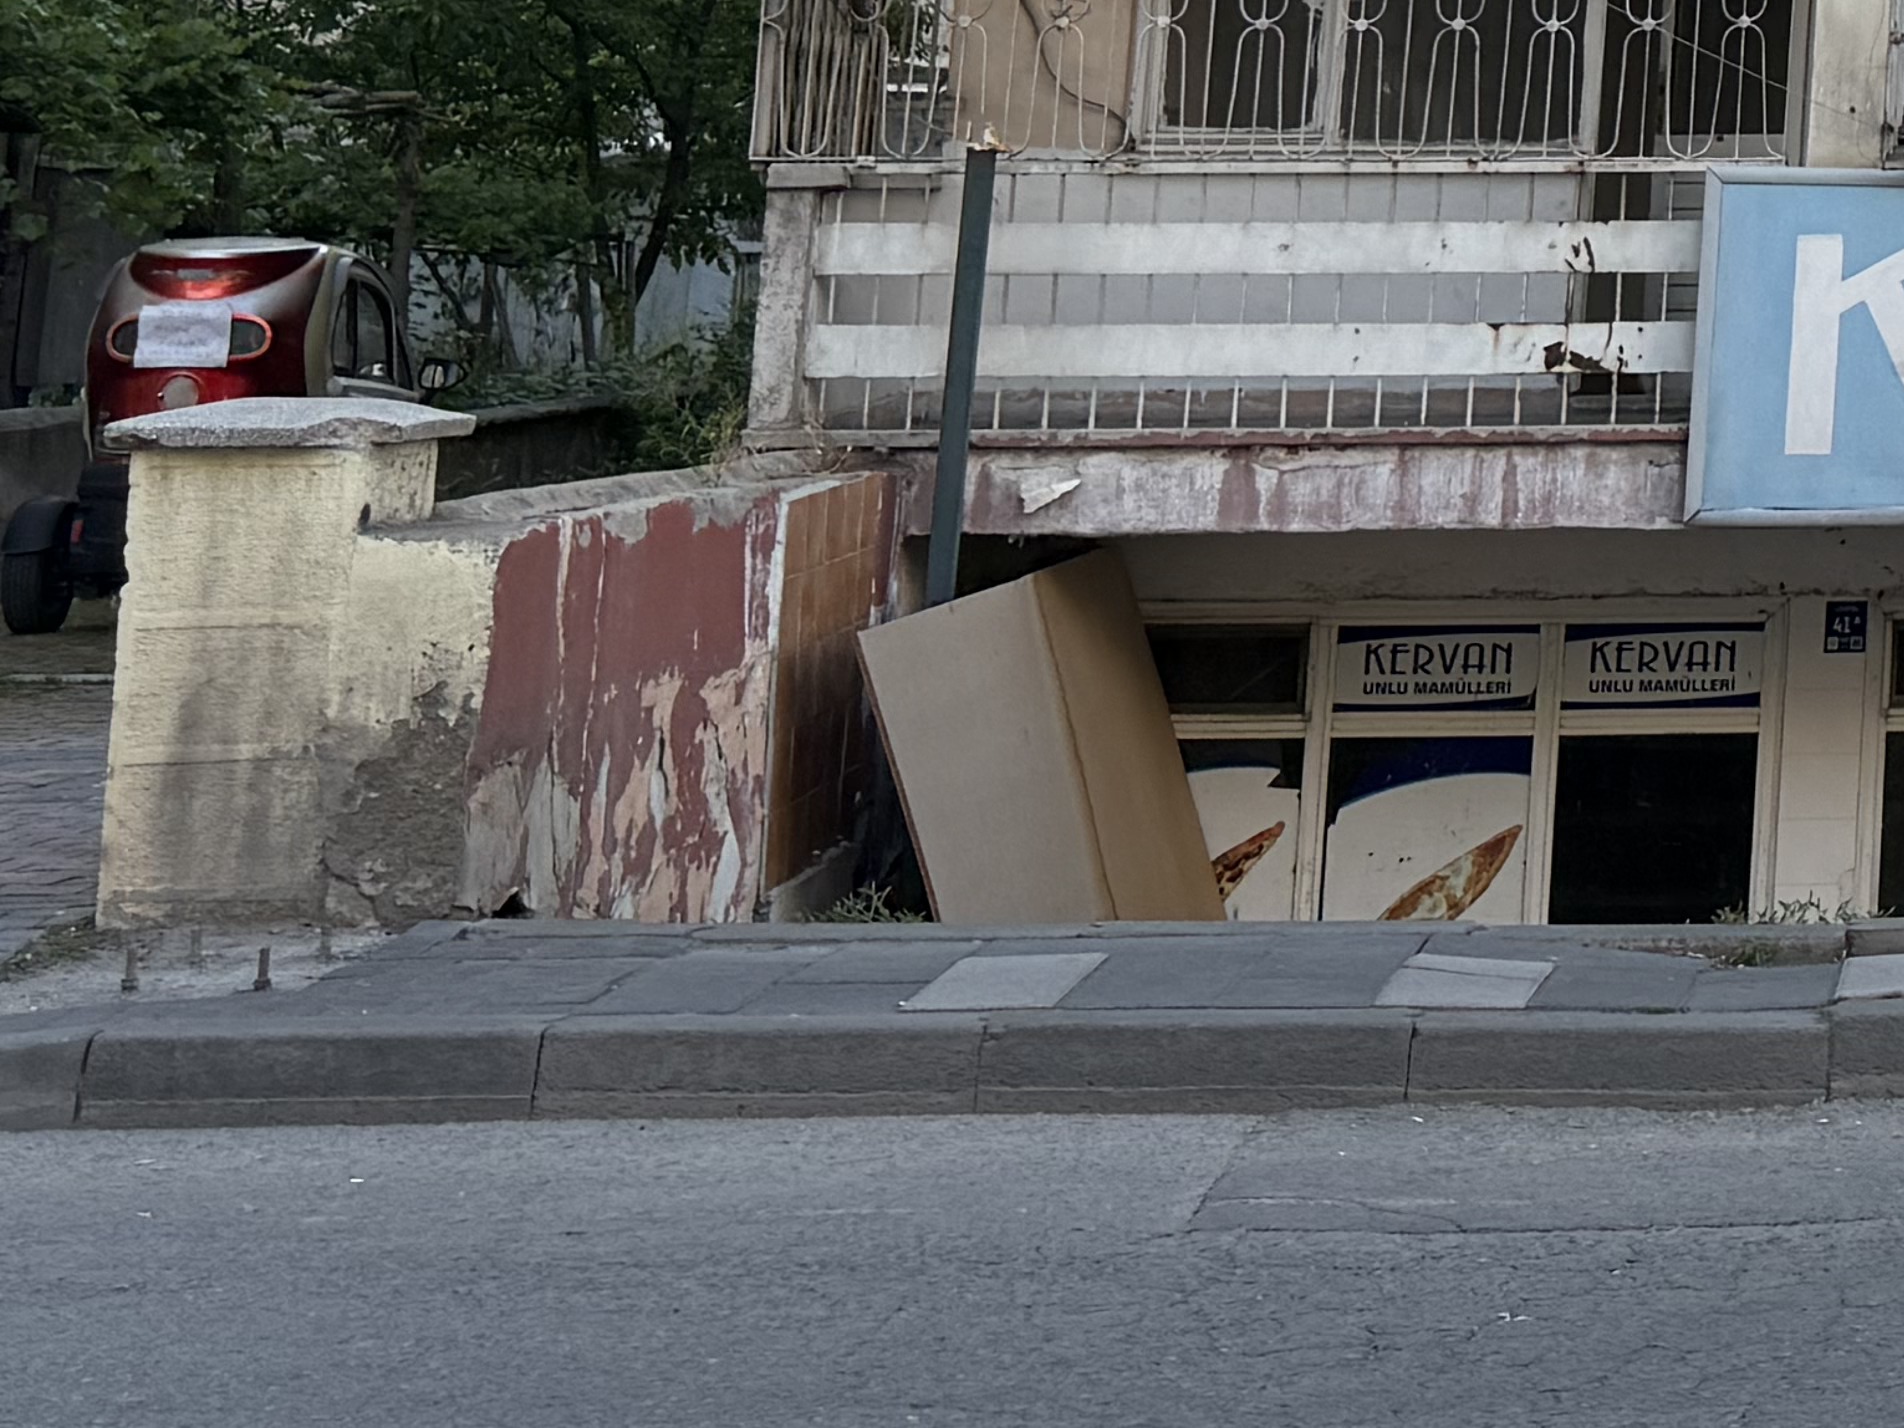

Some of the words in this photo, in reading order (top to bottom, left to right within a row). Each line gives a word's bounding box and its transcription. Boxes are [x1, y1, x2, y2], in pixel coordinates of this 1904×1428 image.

[1364, 642, 1513, 676] KERVAN
[1590, 639, 1737, 674] KERVAN
[1363, 681, 1409, 695] UNLU
[1414, 677, 1511, 695] MAMÜLLERİ
[1589, 679, 1634, 693] UNLU
[1638, 674, 1736, 693] MAMÜLLERİ
